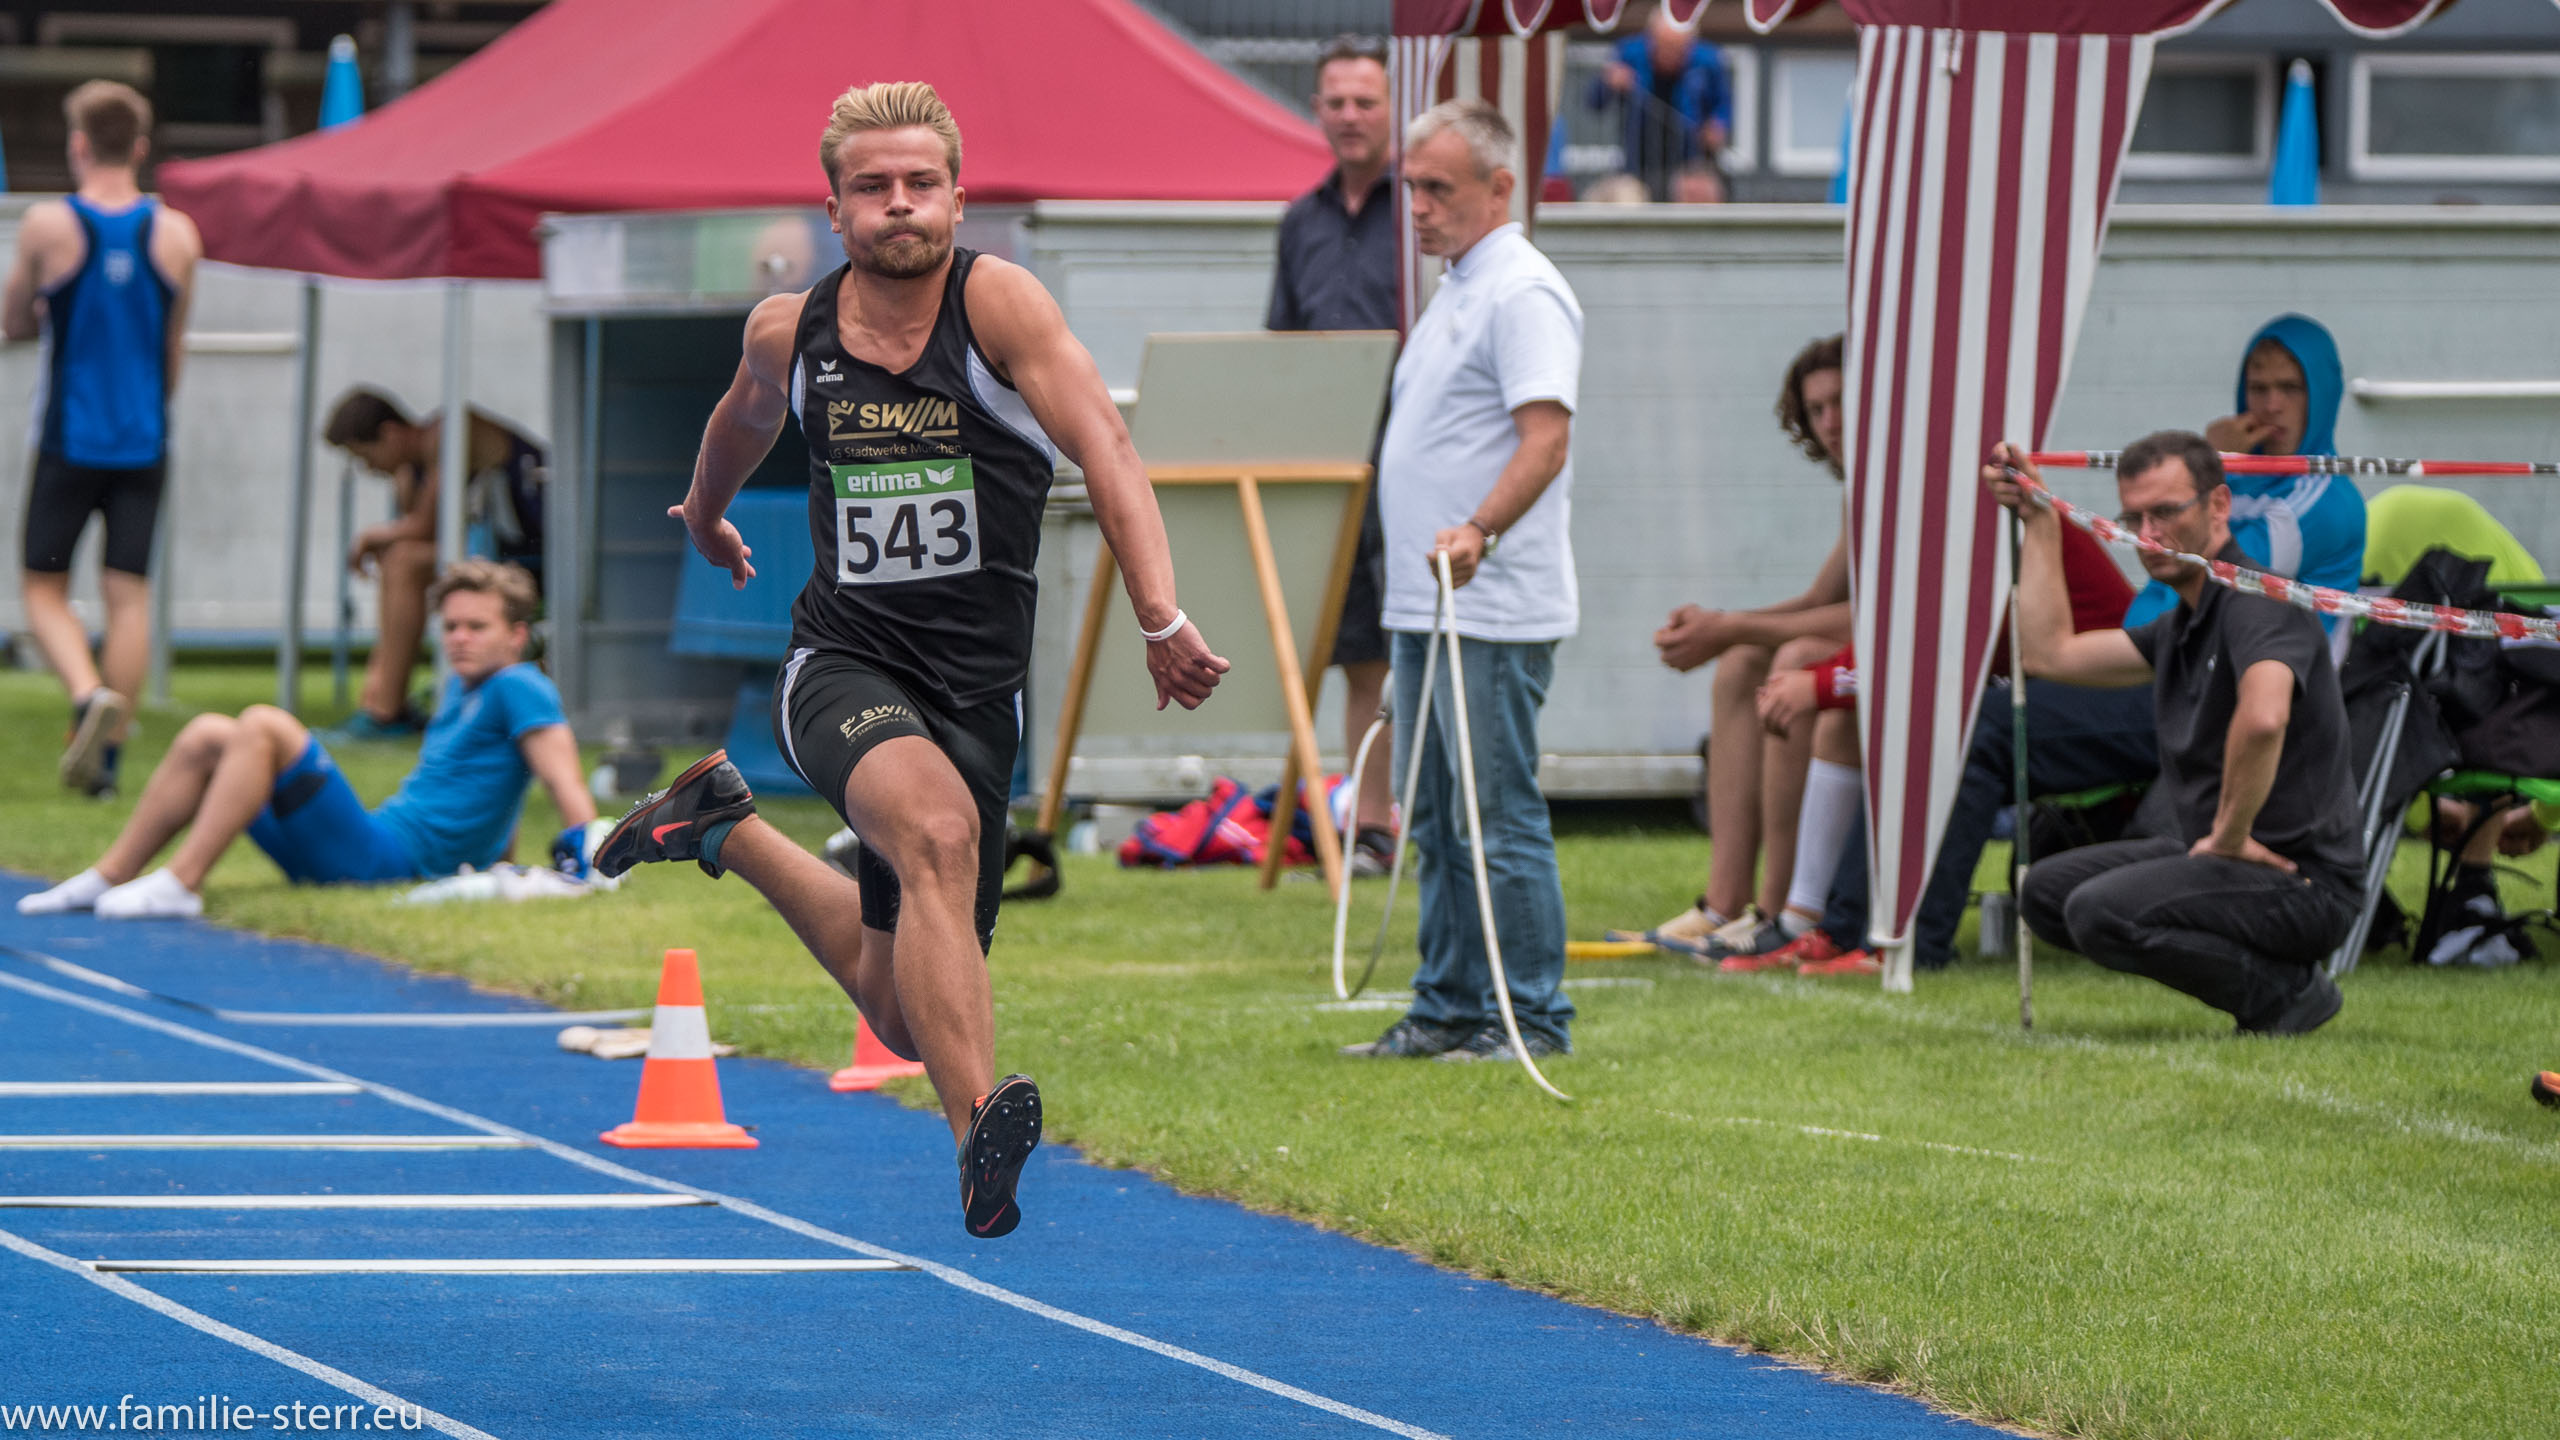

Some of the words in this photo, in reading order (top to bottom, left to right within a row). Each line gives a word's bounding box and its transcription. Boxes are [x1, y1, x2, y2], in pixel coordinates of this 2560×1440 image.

[816, 373, 843, 383] erima
[844, 443, 907, 458] Stadtwerke
[847, 471, 922, 493] erima
[846, 499, 972, 575] 543
